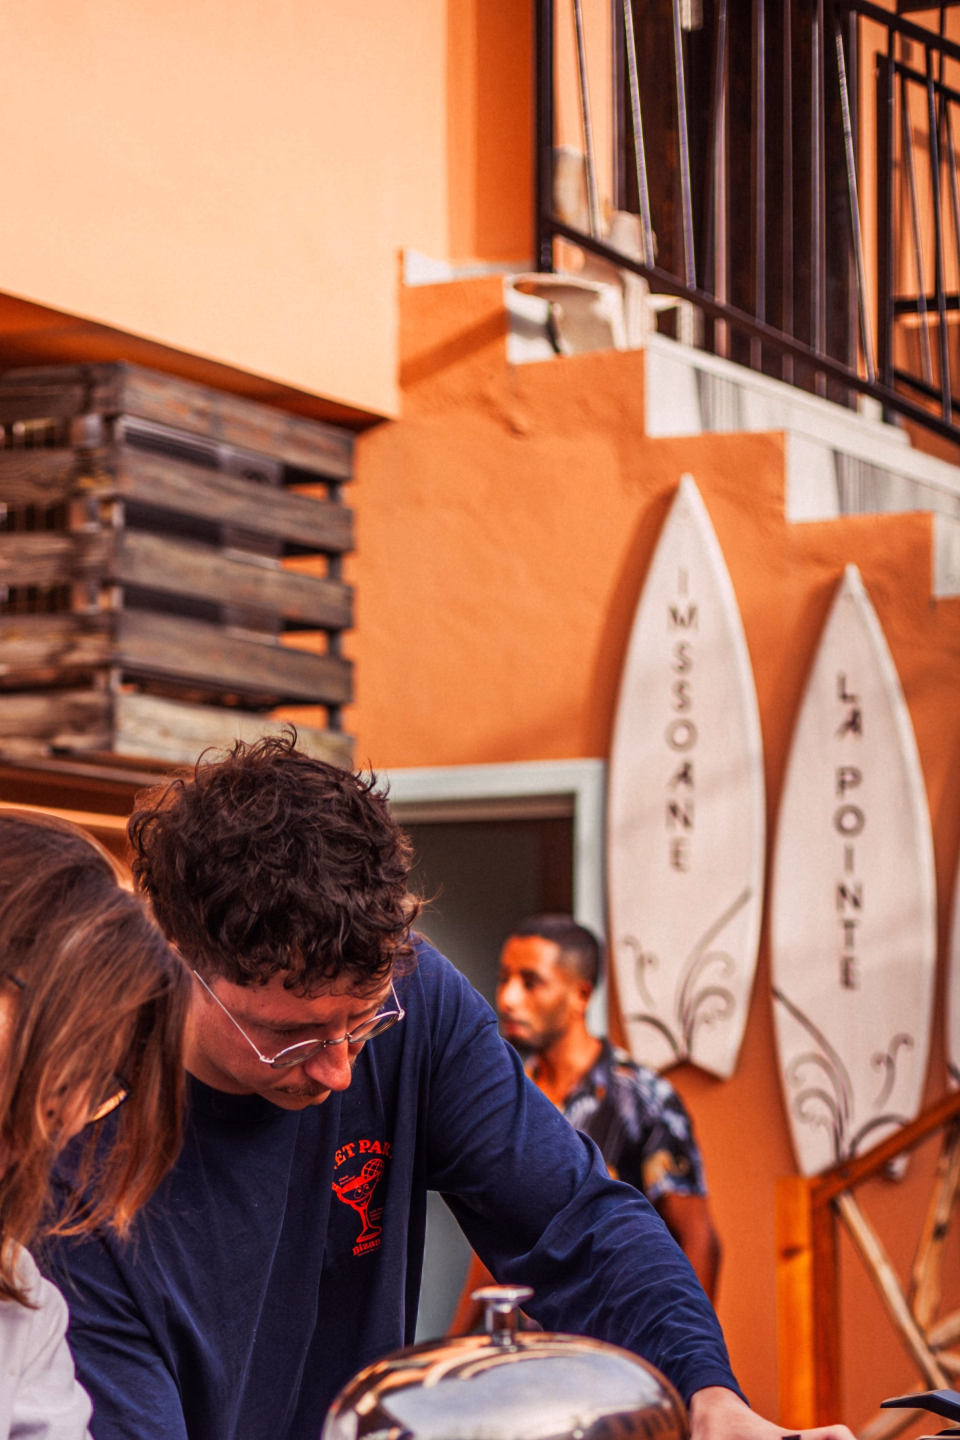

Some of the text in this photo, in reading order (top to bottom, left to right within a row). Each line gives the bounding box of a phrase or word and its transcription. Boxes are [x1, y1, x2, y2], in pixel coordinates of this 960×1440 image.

[834, 673, 865, 990] LA POINTE
[333, 1139, 392, 1169] ET PAR
